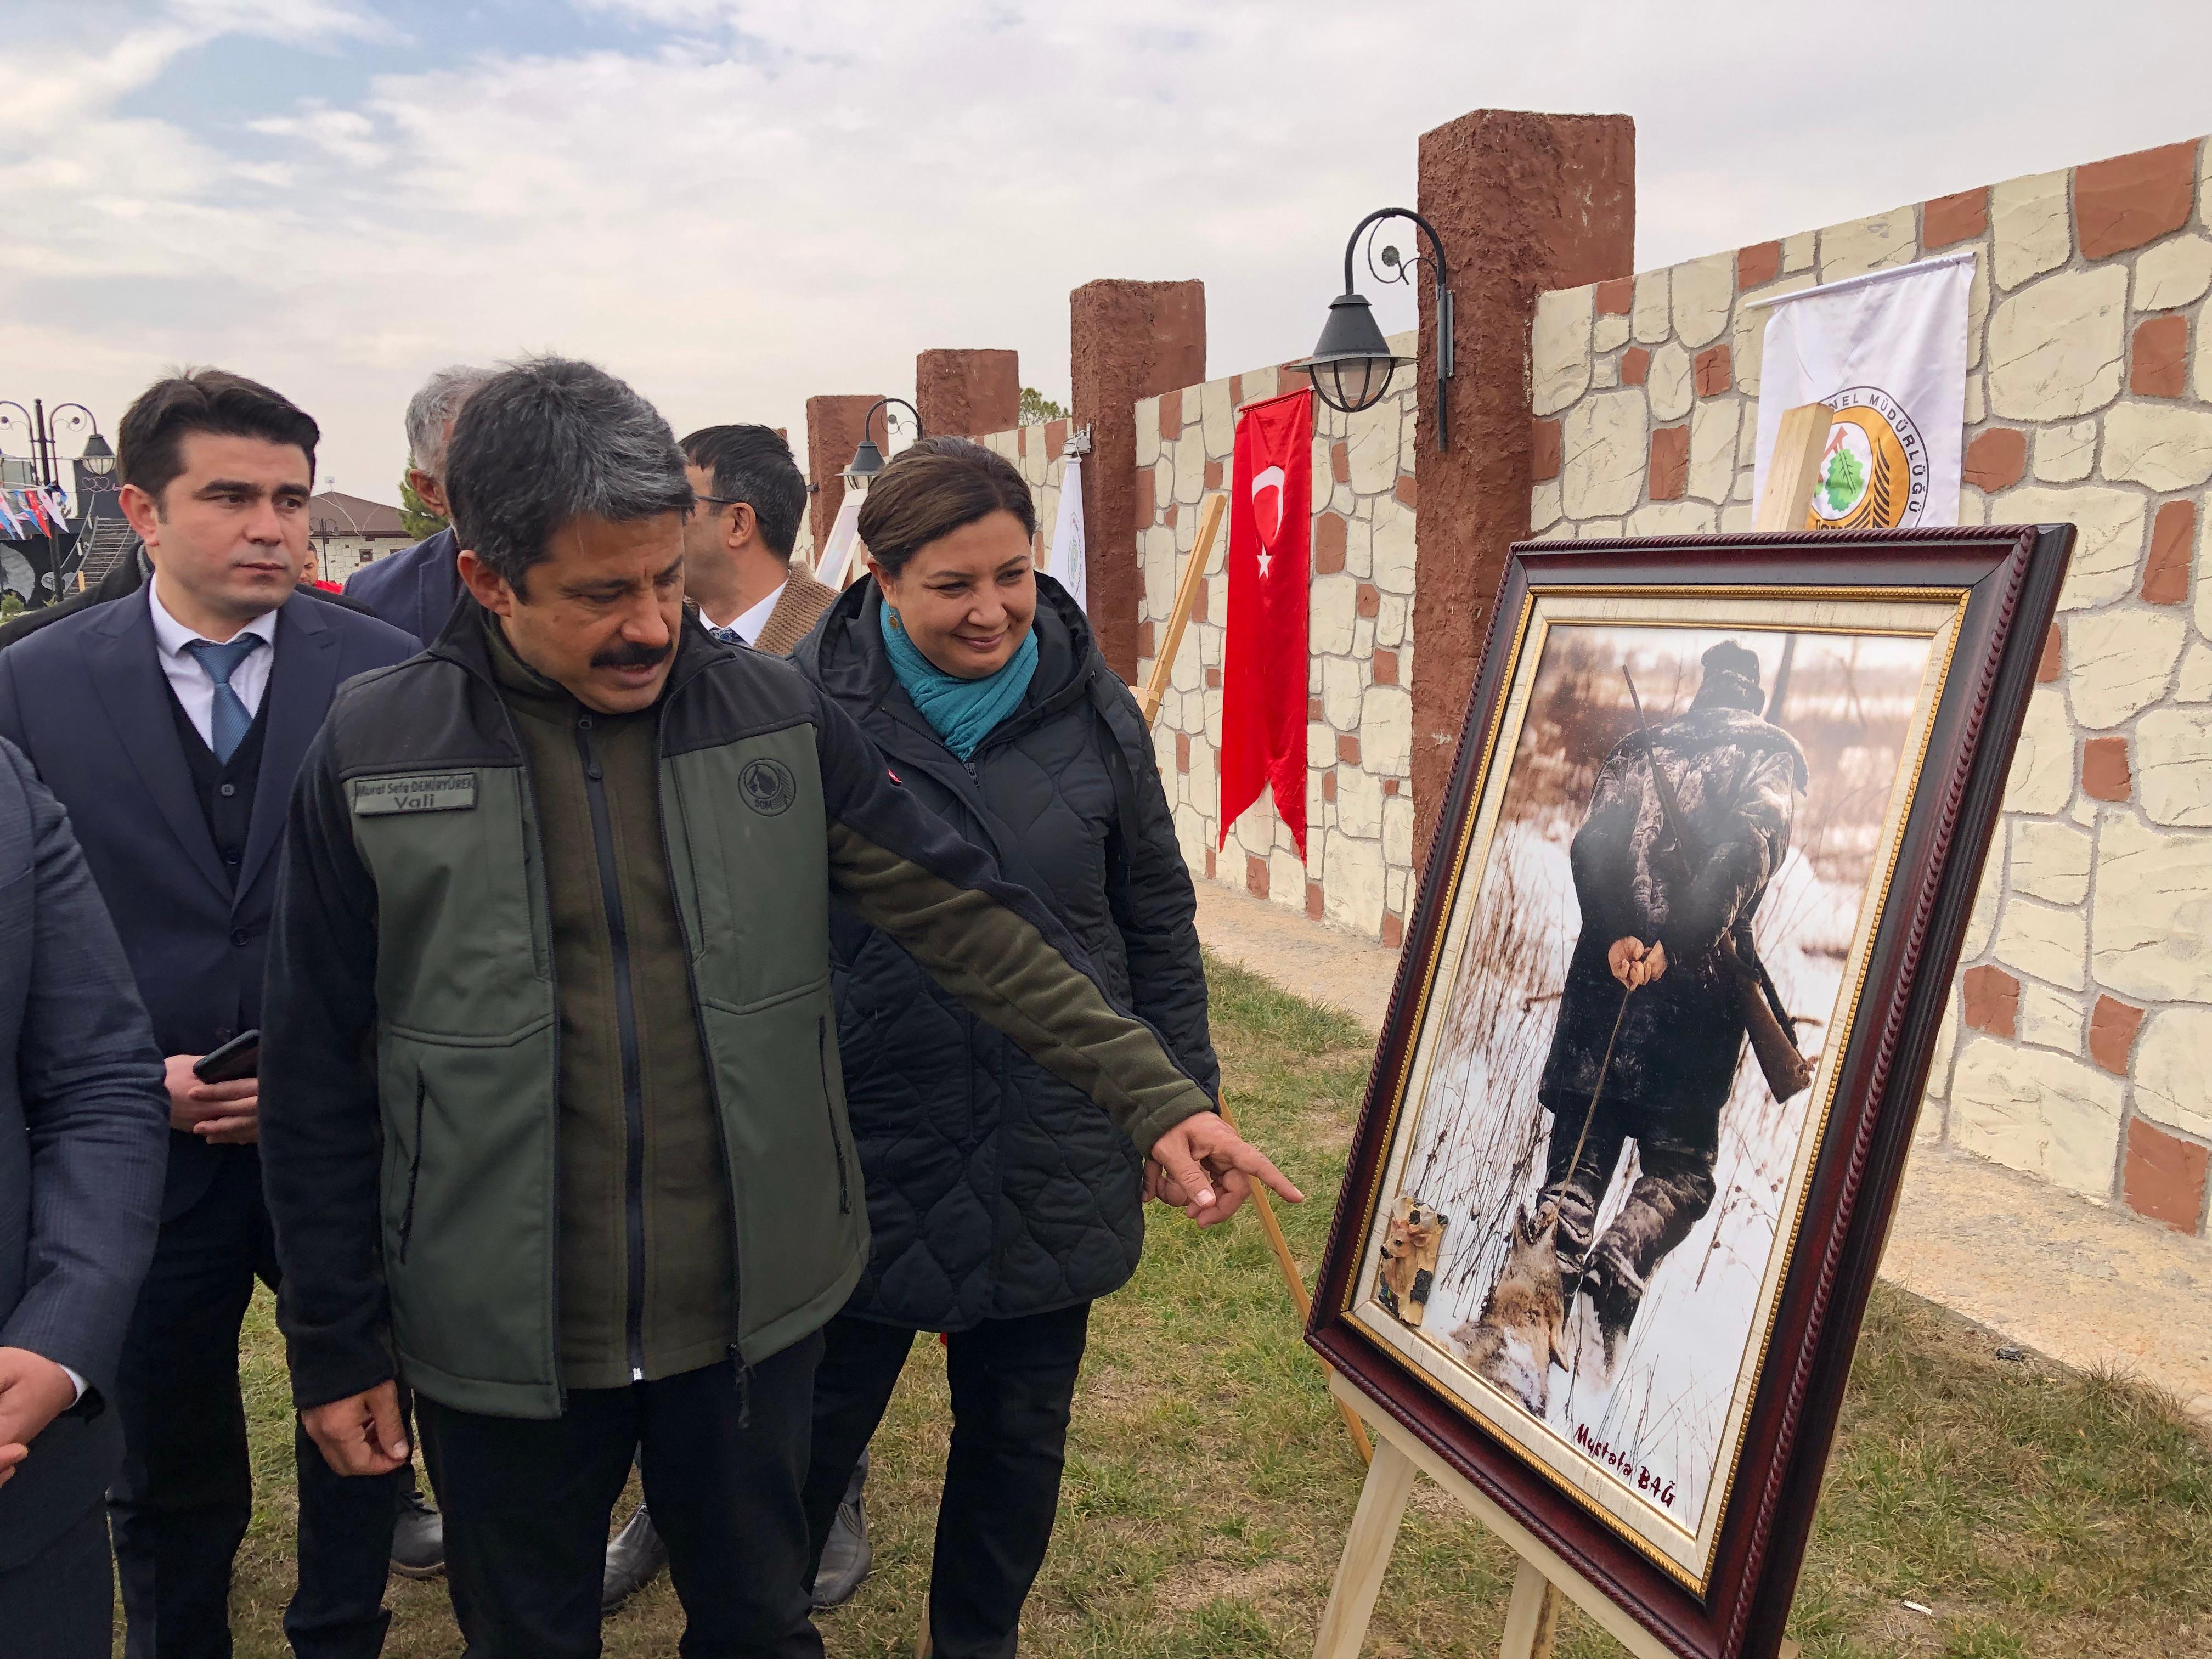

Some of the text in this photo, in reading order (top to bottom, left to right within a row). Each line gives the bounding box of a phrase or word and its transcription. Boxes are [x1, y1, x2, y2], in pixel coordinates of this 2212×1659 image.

[1828, 393, 1926, 512] NEL MÜDÜRLÜĞÜ
[387, 782, 409, 794] Sefa
[394, 794, 435, 809] Vali
[1638, 1466, 1676, 1508] BAĞ
